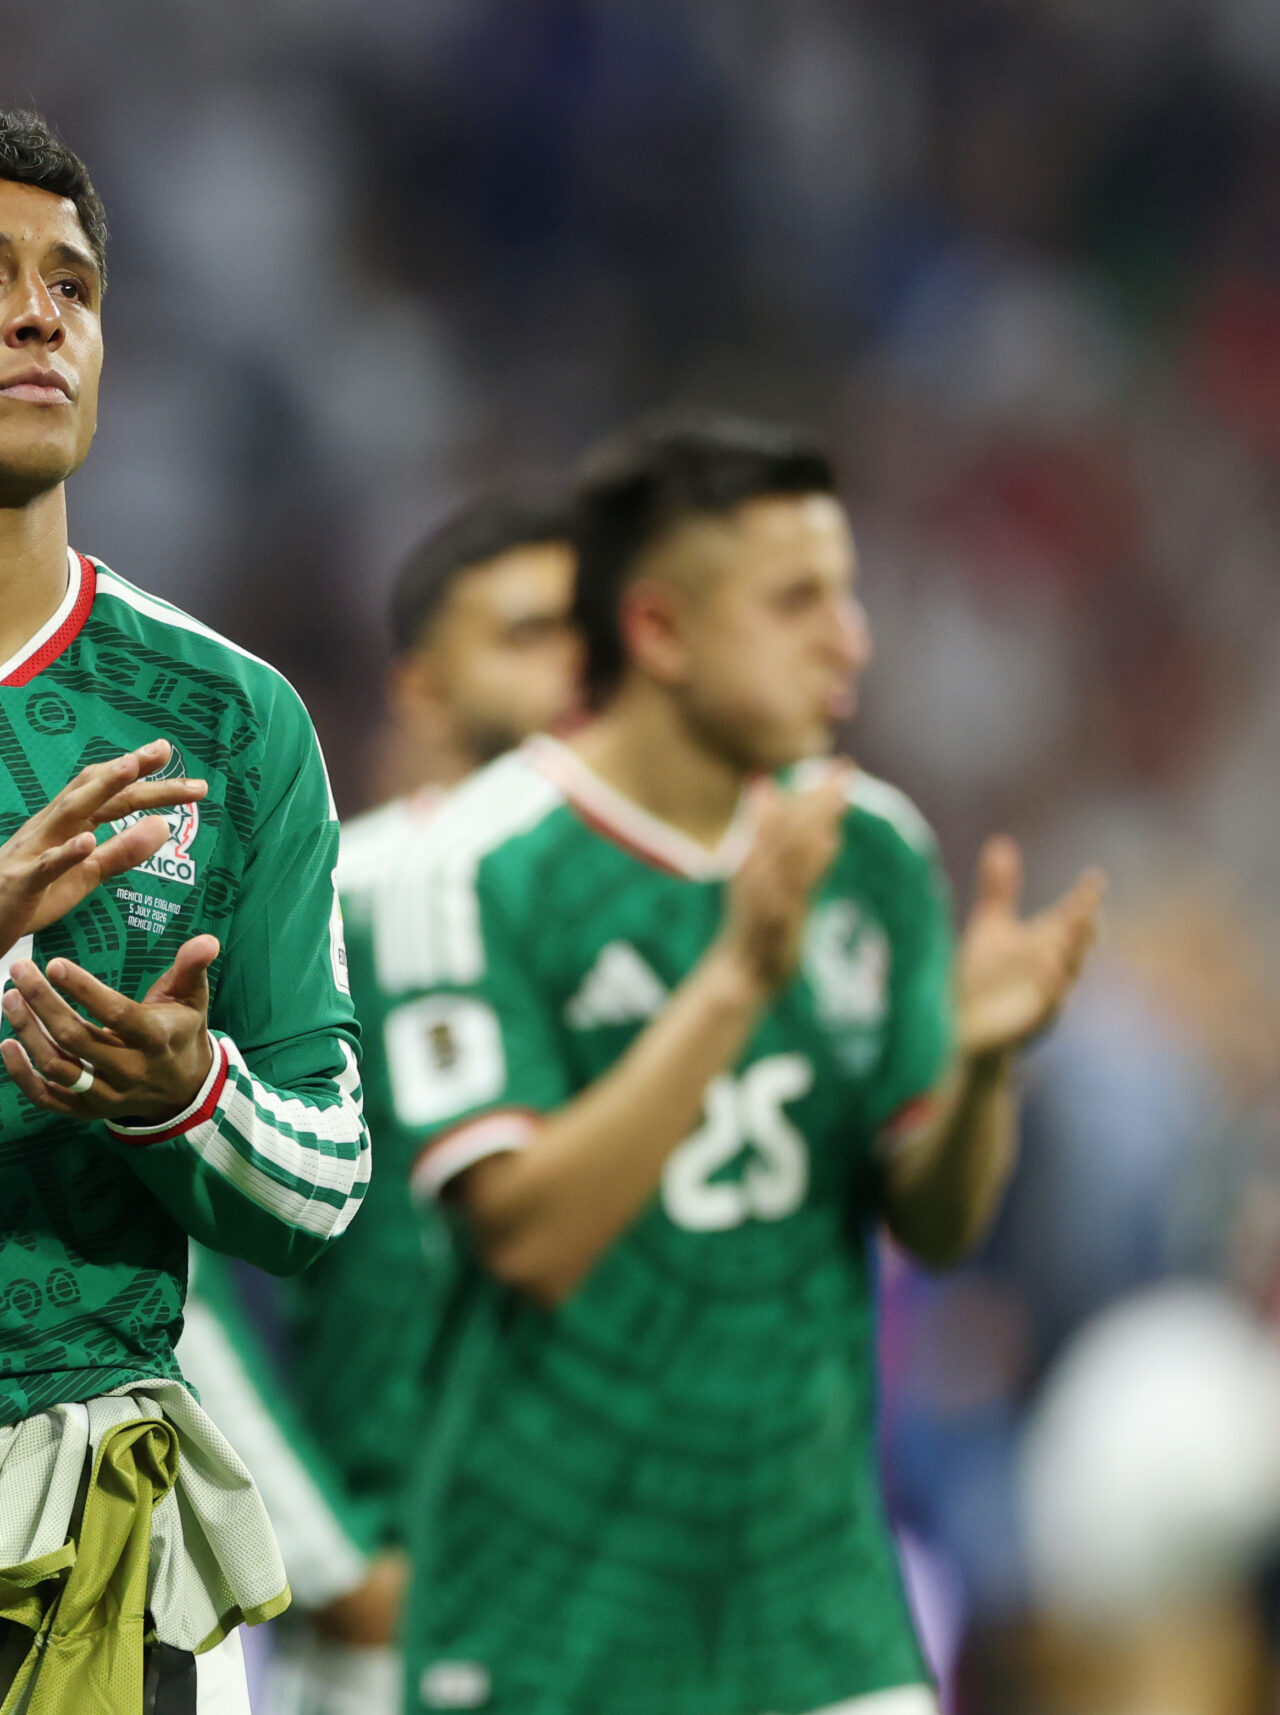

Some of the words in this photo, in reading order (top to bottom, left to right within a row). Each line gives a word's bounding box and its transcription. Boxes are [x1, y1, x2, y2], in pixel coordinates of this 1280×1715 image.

[139, 855, 192, 880] XICO
[116, 888, 143, 903] MEXICO
[144, 894, 153, 907] VS
[154, 897, 181, 915] ENGLAND
[129, 903, 134, 914] 5
[135, 905, 151, 918] JULY
[151, 909, 167, 924] 2026
[127, 915, 153, 931] MEXICO
[152, 923, 165, 935] CITY
[662, 1054, 812, 1230] 25
